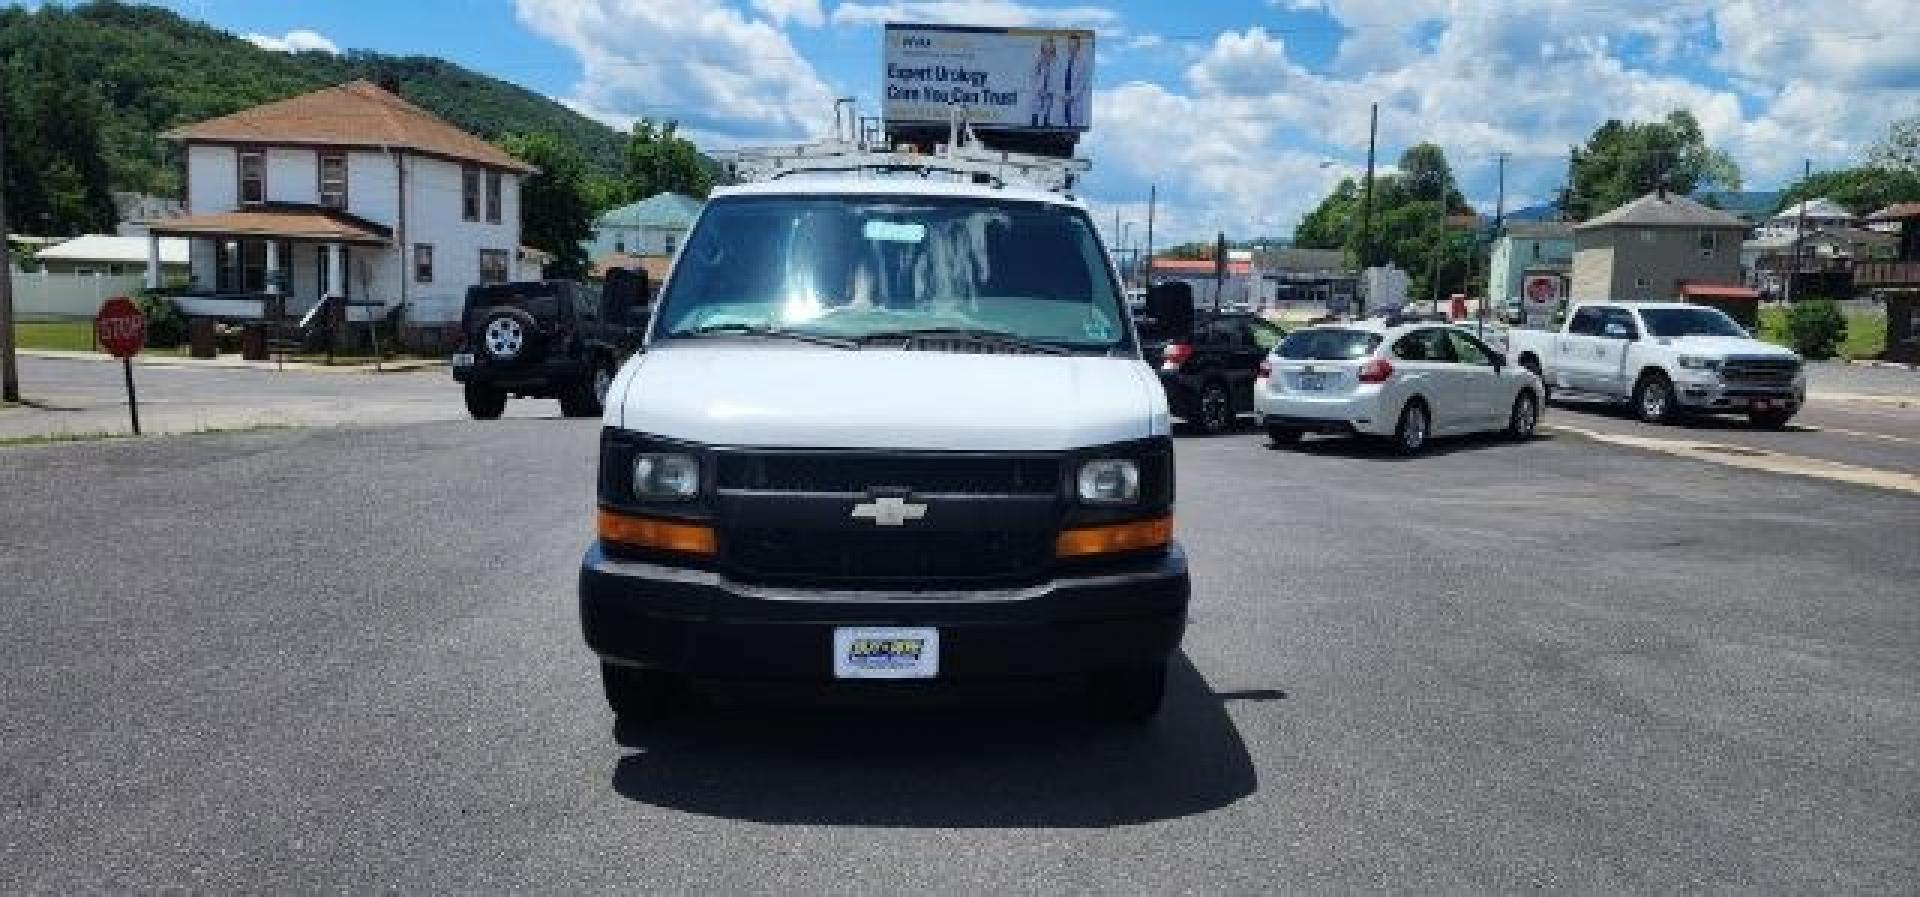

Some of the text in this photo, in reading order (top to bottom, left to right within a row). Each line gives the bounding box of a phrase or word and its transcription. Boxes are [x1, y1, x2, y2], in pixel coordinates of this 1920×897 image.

[887, 63, 988, 87] Expert Urology
[887, 84, 1018, 105] Care You Can Trust
[101, 315, 142, 339] STOP
